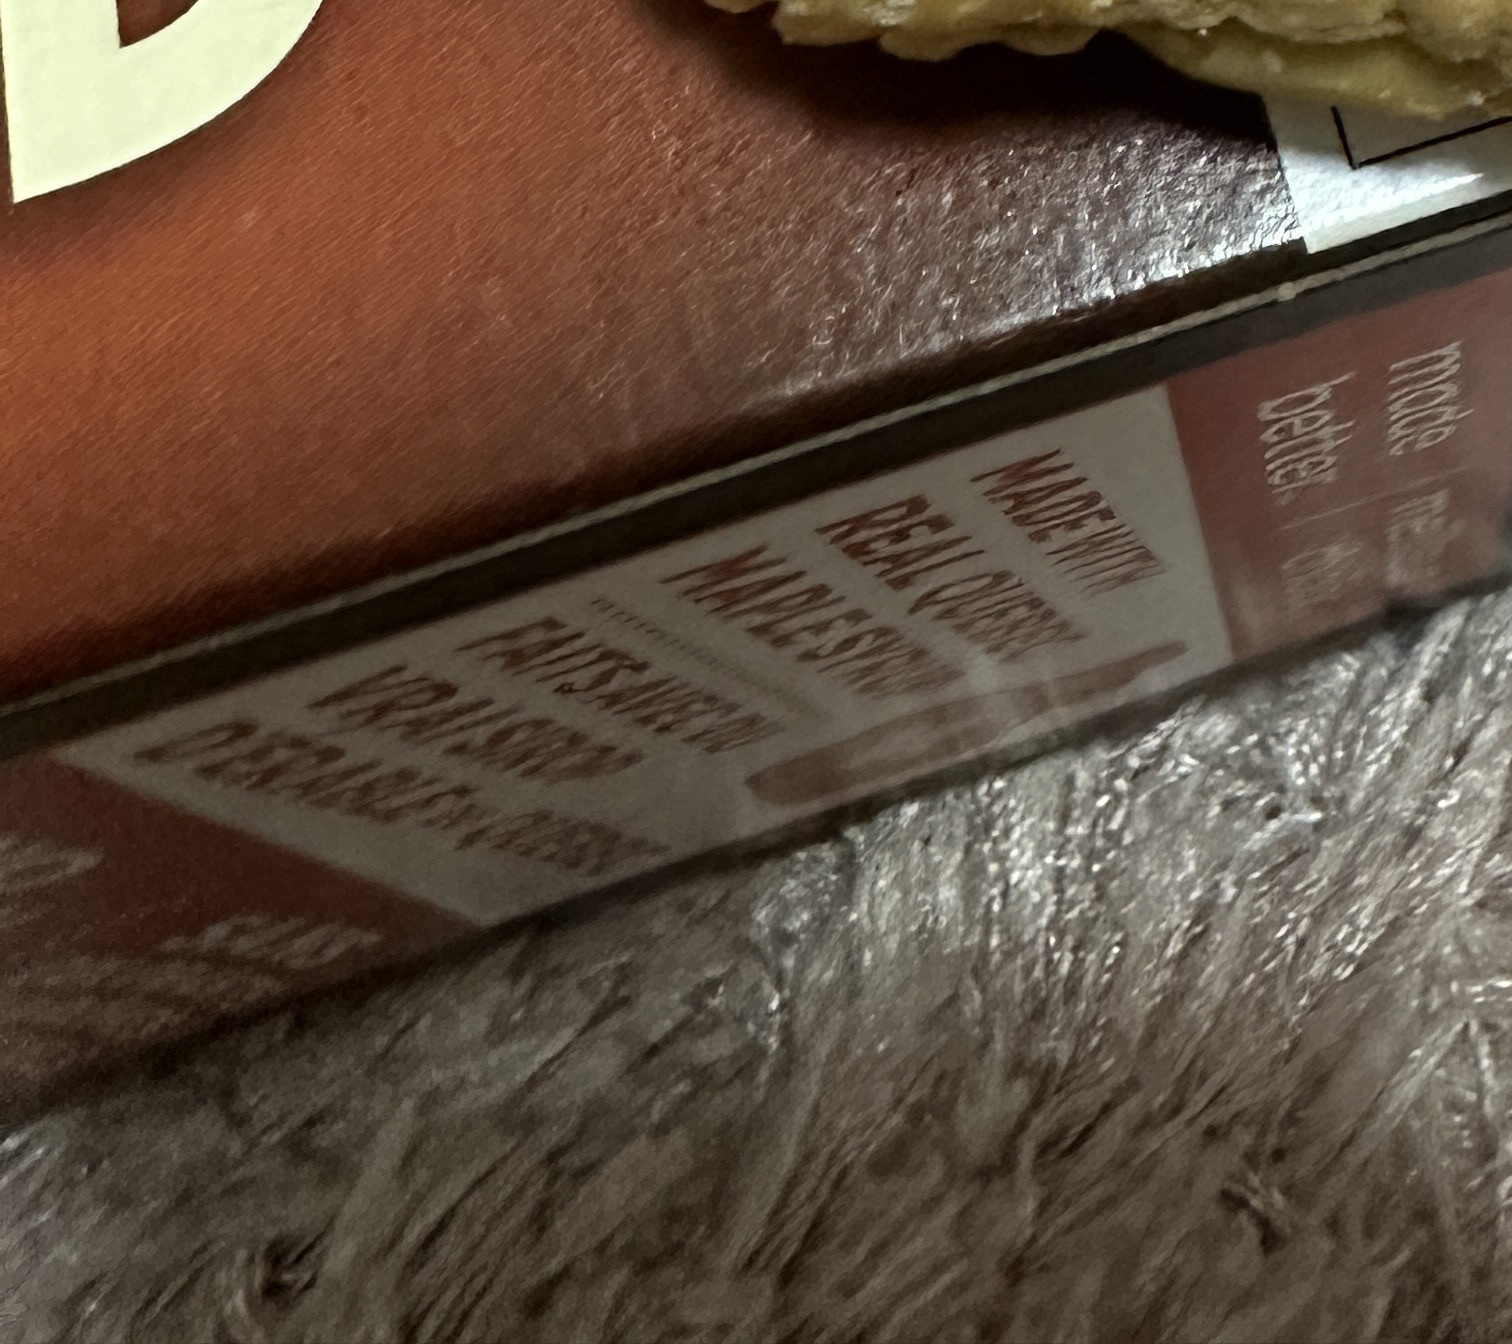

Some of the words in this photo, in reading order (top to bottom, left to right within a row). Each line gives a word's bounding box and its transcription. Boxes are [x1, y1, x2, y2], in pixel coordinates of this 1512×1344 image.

[1387, 340, 1475, 456] made
[814, 495, 986, 592] REAL
[968, 447, 1117, 544] MADE
[659, 545, 874, 649] MAPLE
